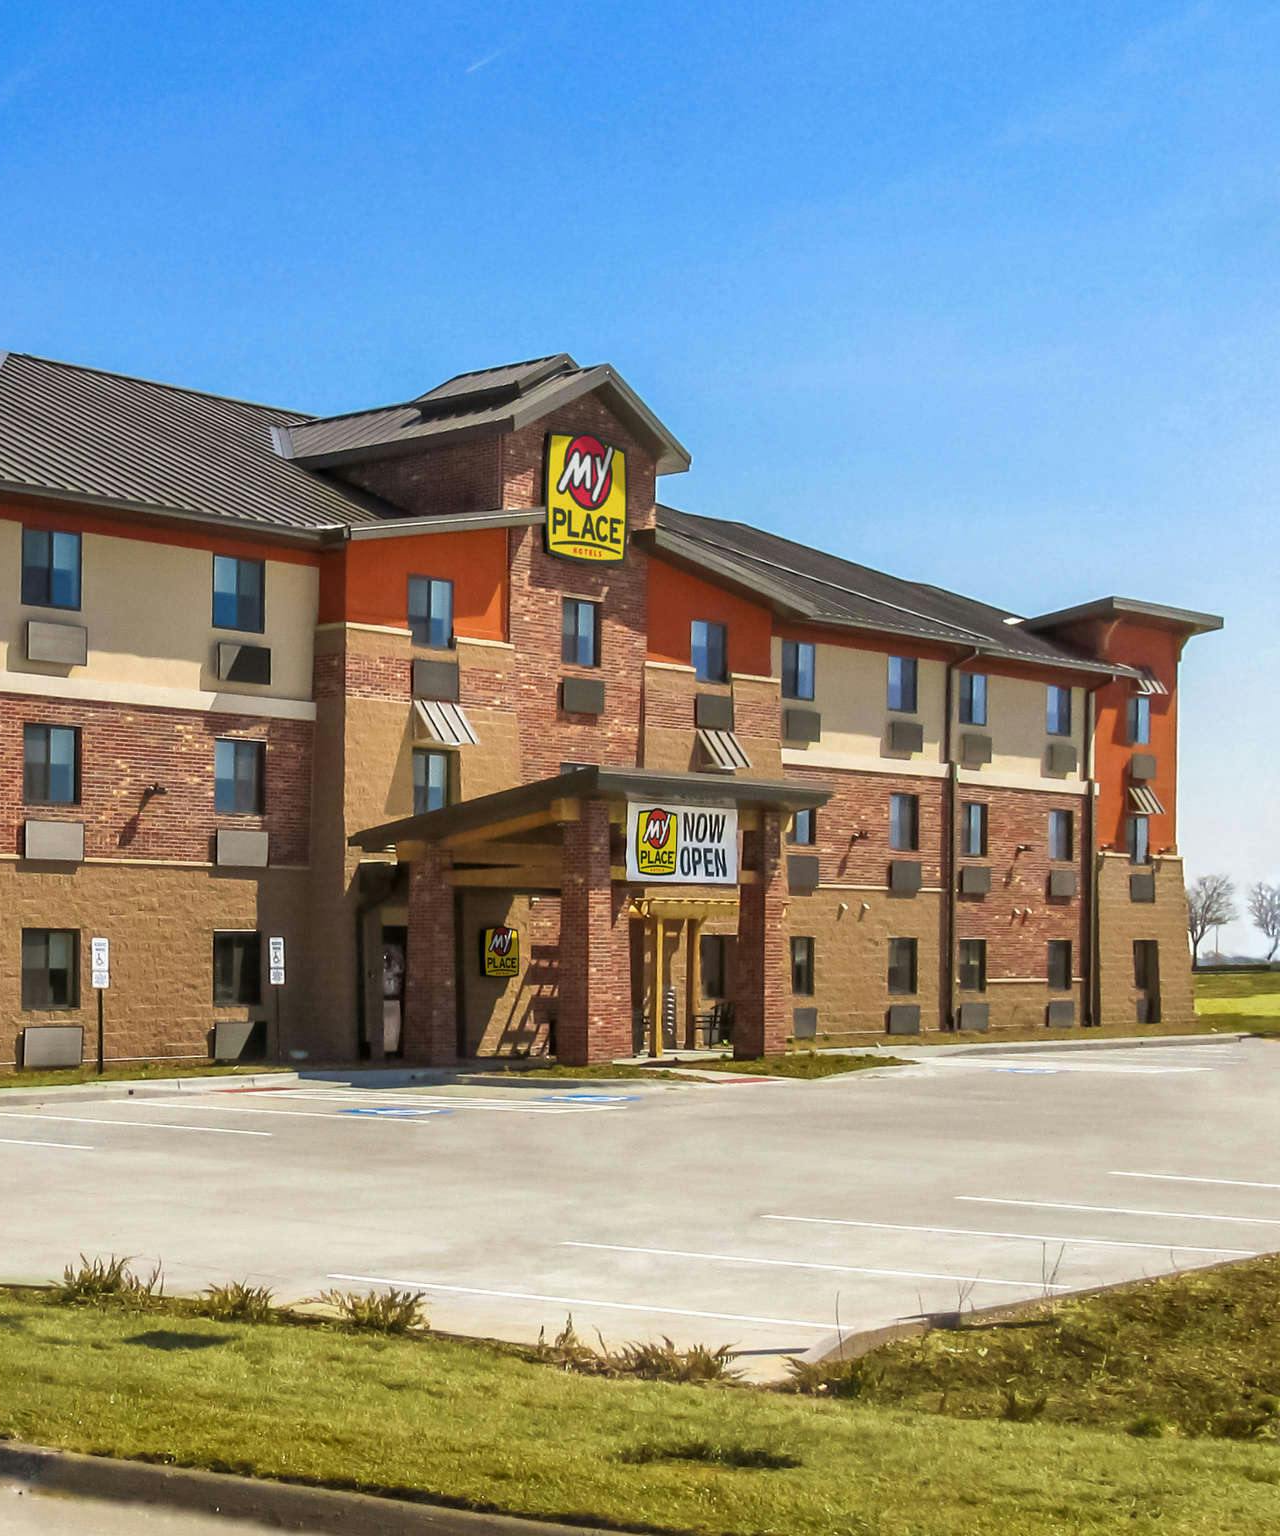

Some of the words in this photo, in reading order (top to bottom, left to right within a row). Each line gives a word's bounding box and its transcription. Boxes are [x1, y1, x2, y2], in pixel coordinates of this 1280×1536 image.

[552, 507, 623, 544] PLACE
[683, 812, 727, 843] NOW
[640, 850, 675, 864] PLACE
[680, 846, 728, 877] OPEN
[487, 957, 517, 969] PLACE
